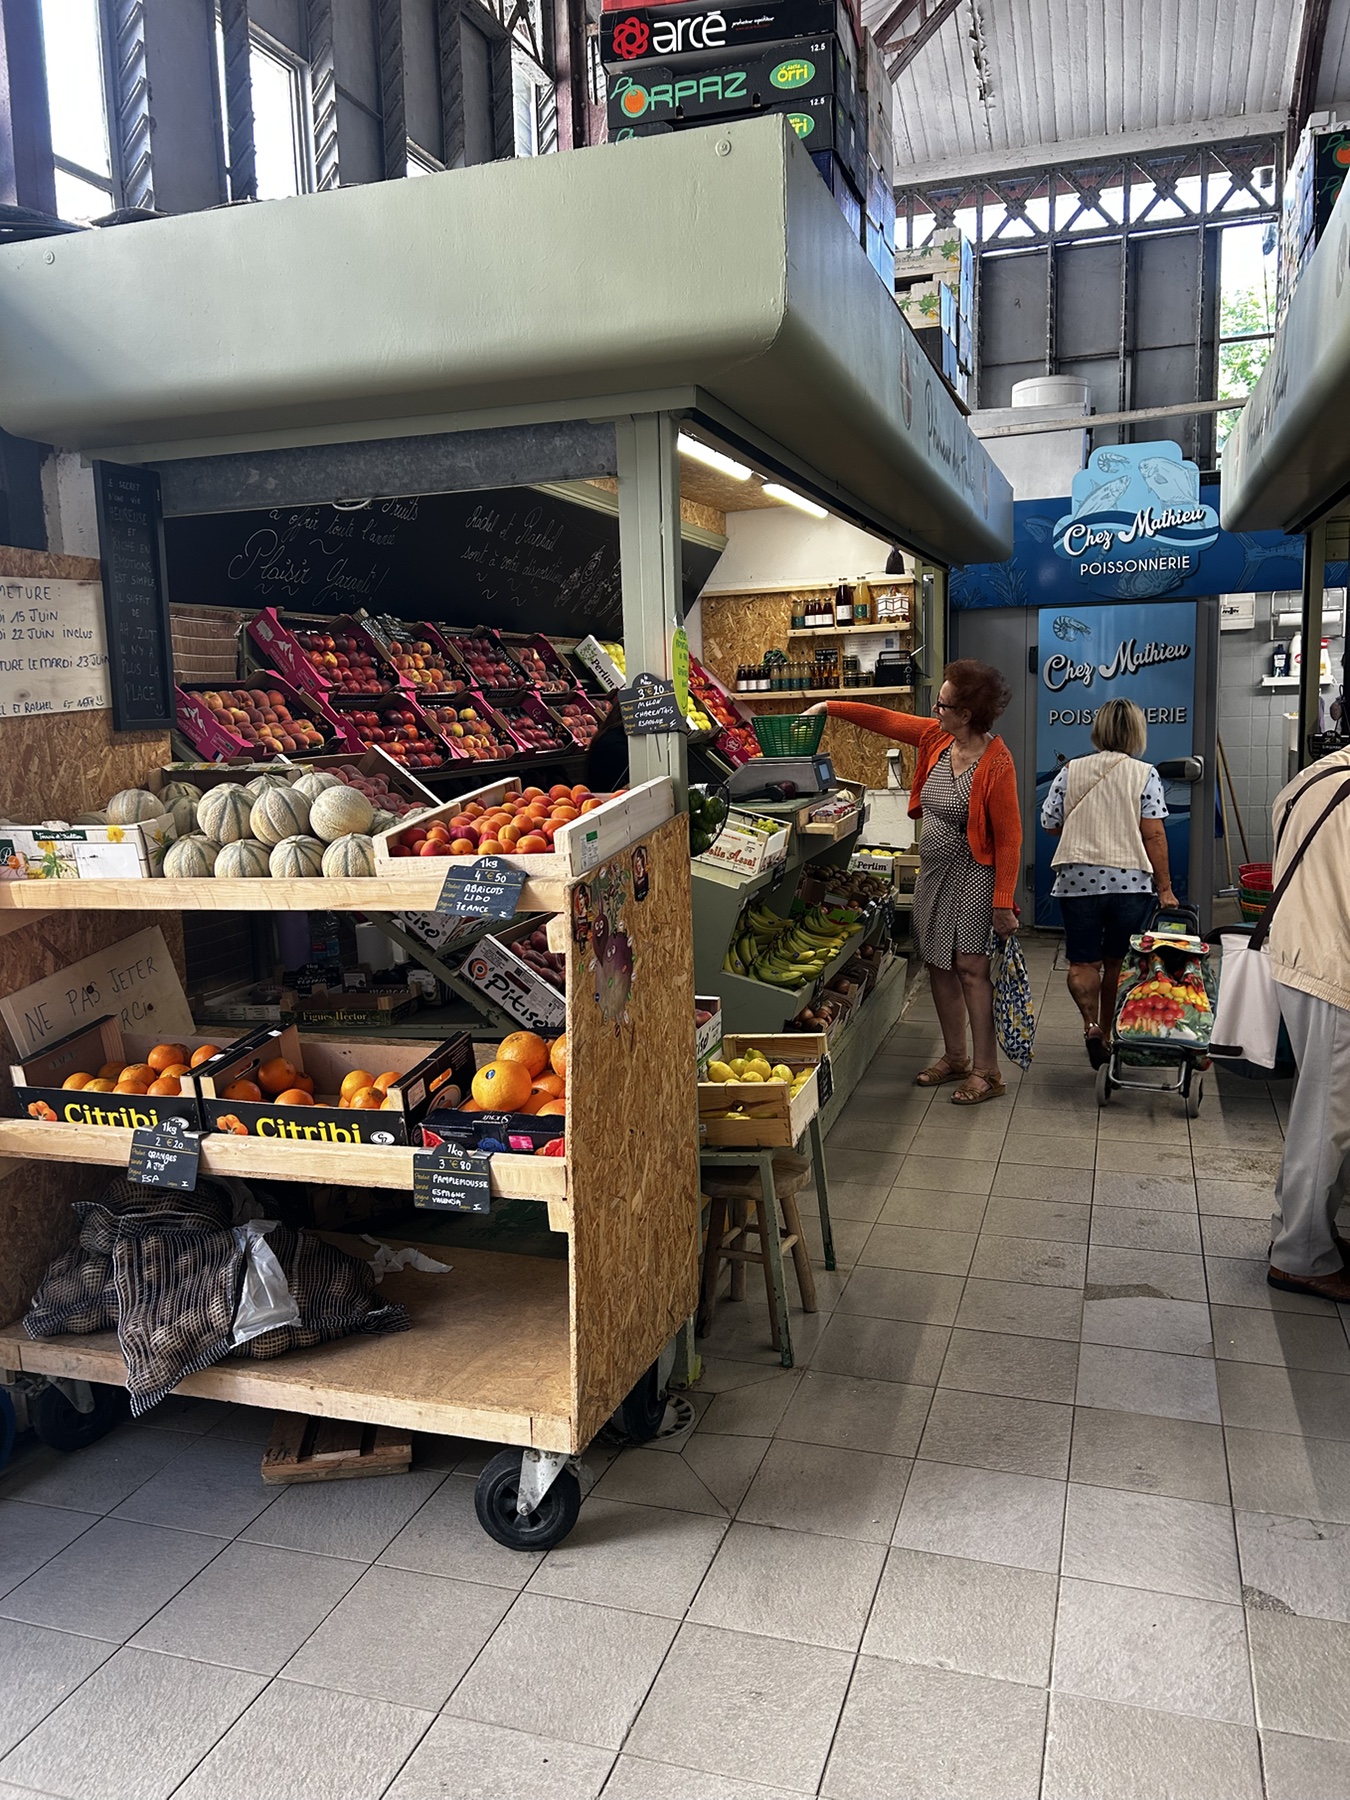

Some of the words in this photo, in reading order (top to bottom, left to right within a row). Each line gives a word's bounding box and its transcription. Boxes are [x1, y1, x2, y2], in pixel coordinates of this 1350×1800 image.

[1063, 523, 1115, 556] Chez
[1118, 505, 1206, 543] Mathieu
[1080, 555, 1190, 576] POISSONNERIE
[1043, 653, 1093, 690] Chez
[1098, 639, 1190, 678] Mathieu
[591, 658, 616, 689] Perlim
[124, 681, 156, 702] PLACE
[637, 689, 645, 700] 3
[653, 685, 665, 696] 20
[480, 857, 499, 869] 1kg
[857, 861, 888, 871] Perlim
[474, 870, 481, 881] 4
[494, 873, 507, 883] 50
[24, 1002, 53, 1042] NE
[65, 981, 101, 1017] PAS
[106, 956, 159, 994] JETER
[302, 1011, 333, 1022] Figues
[64, 1103, 159, 1128] Citribi
[162, 1122, 177, 1135] 1kg
[256, 1117, 361, 1144] Citribi
[155, 1137, 161, 1146] 2
[172, 1140, 184, 1149] 20
[439, 1159, 445, 1169] 3
[460, 1161, 471, 1171] 80
[432, 1174, 489, 1188] PAMPLEMOUSSE
